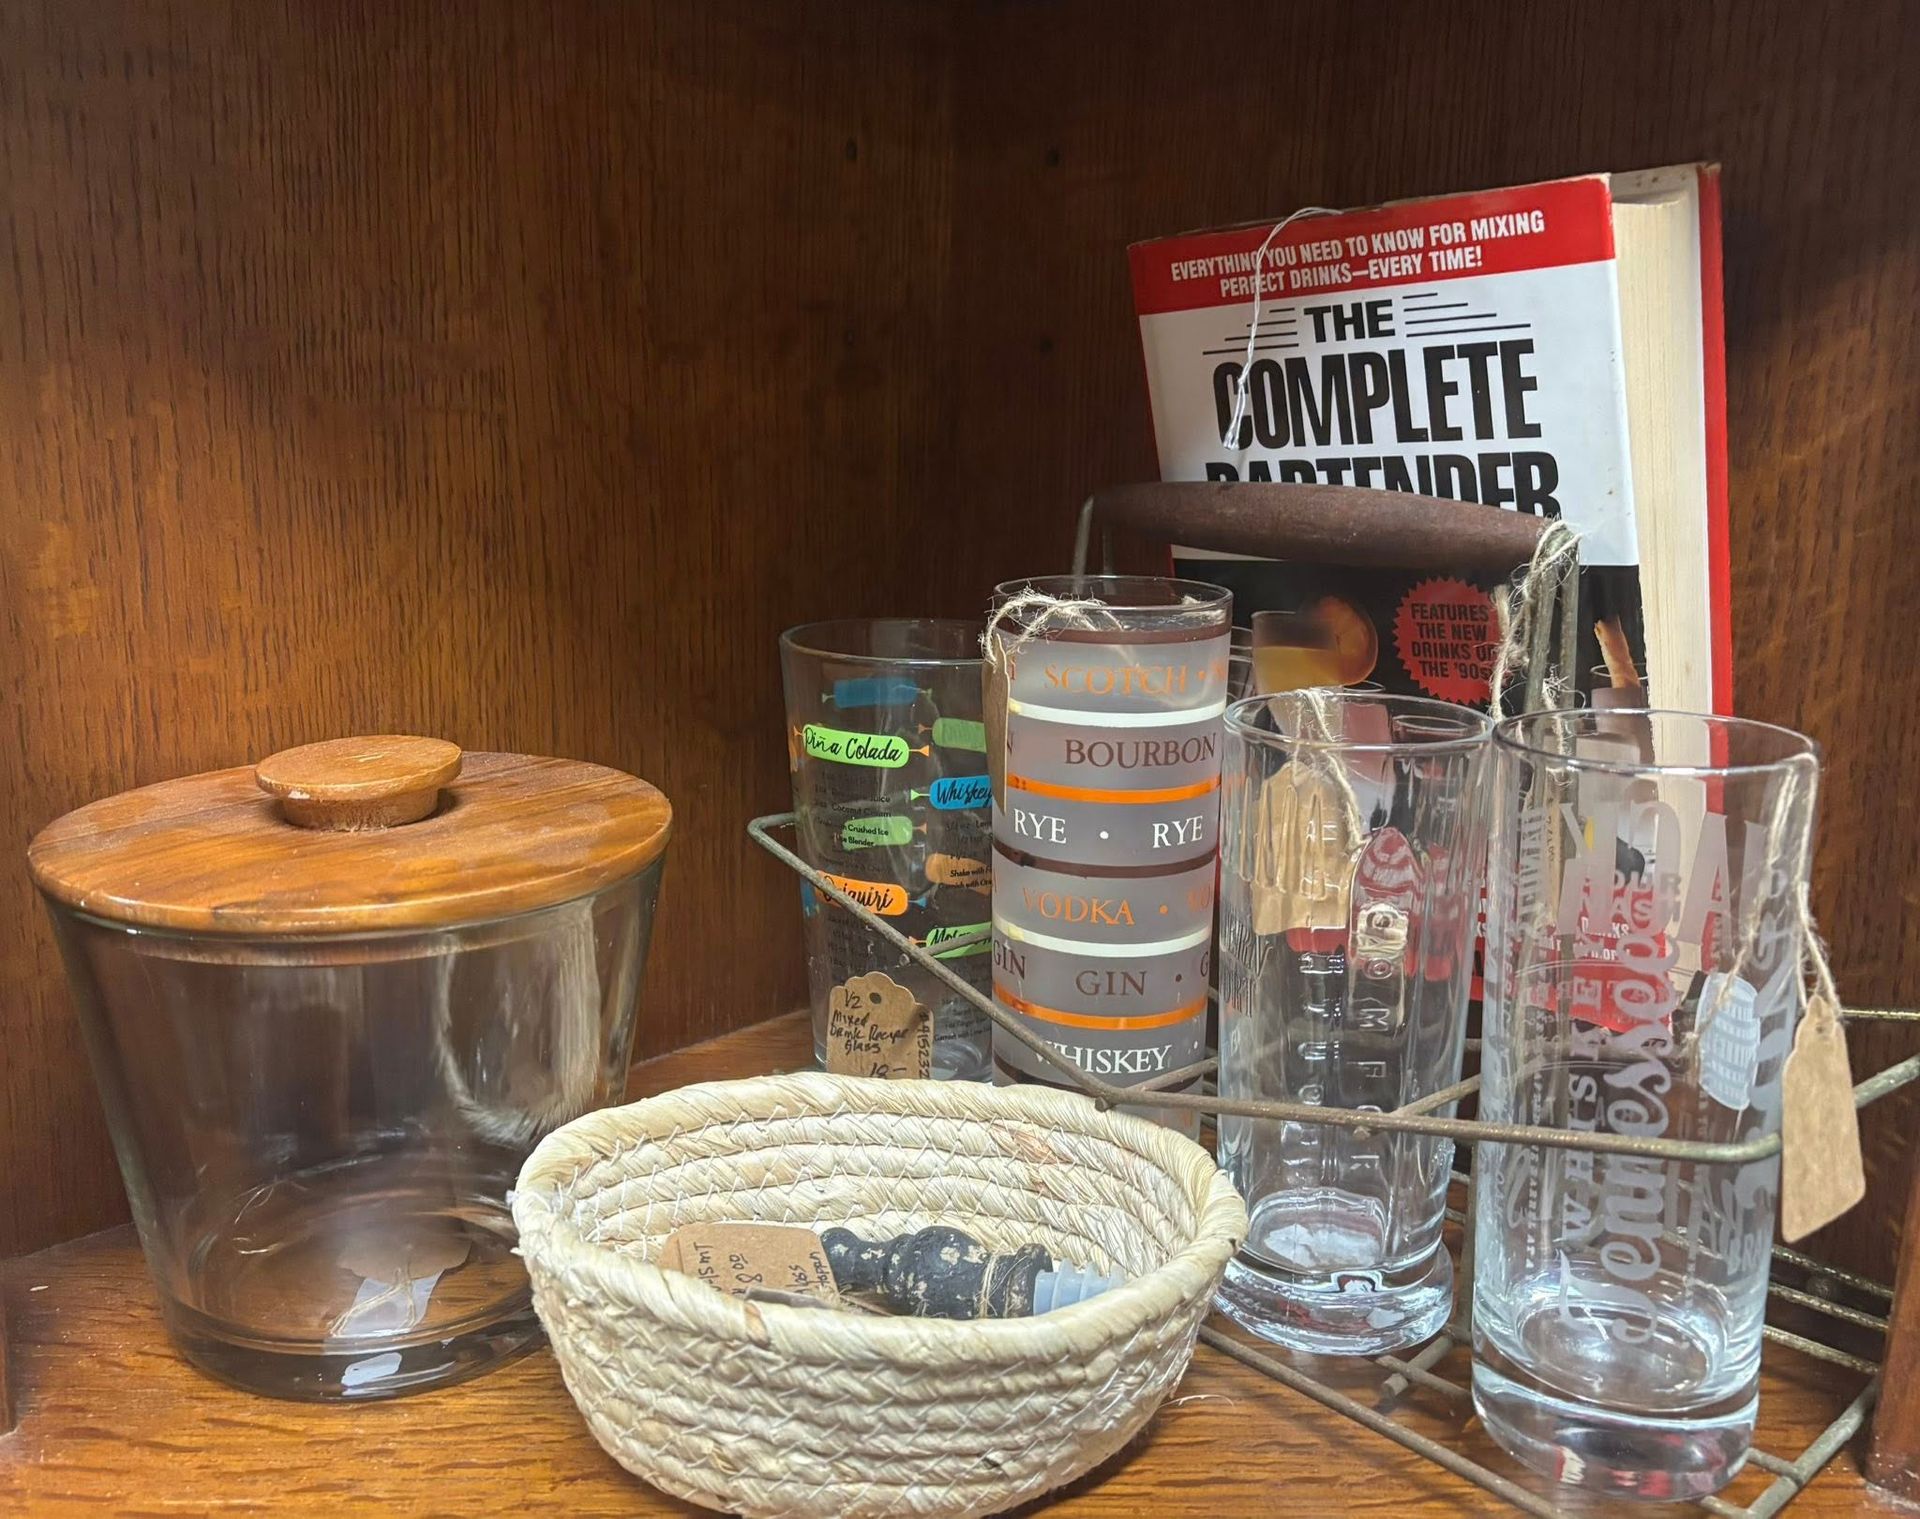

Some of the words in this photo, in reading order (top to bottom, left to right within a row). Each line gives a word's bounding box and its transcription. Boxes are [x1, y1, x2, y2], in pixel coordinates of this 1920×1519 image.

[1171, 251, 1262, 281] EVERYTHING
[1265, 245, 1297, 268] YOU
[1301, 239, 1342, 264] NEED
[1345, 234, 1368, 258] TO
[1372, 227, 1424, 254] KNOW
[1429, 222, 1466, 246] FOR
[1471, 209, 1545, 242] MIXING
[1220, 271, 1285, 298] PERFECT
[1428, 245, 1483, 272] TIME!
[1303, 299, 1396, 343] THE
[1212, 338, 1543, 450] COMPLETE
[1411, 603, 1489, 622] FEATURES
[1416, 622, 1446, 639] THE
[1451, 624, 1487, 641] NEW
[1411, 641, 1471, 659] DRINKS
[1044, 662, 1188, 697] SCOTCH
[1419, 661, 1449, 678] THE
[805, 728, 842, 755] Piña
[846, 737, 903, 761] Colada
[1065, 733, 1216, 769] BOURBON
[848, 824, 876, 835] Crushed
[878, 828, 889, 837] Ice
[848, 836, 874, 846] Blender
[1013, 808, 1067, 844] RYE
[1152, 815, 1203, 849] RYE
[1022, 887, 1136, 926] VODKA
[993, 939, 1026, 980] GIN
[1075, 970, 1147, 996] GIN
